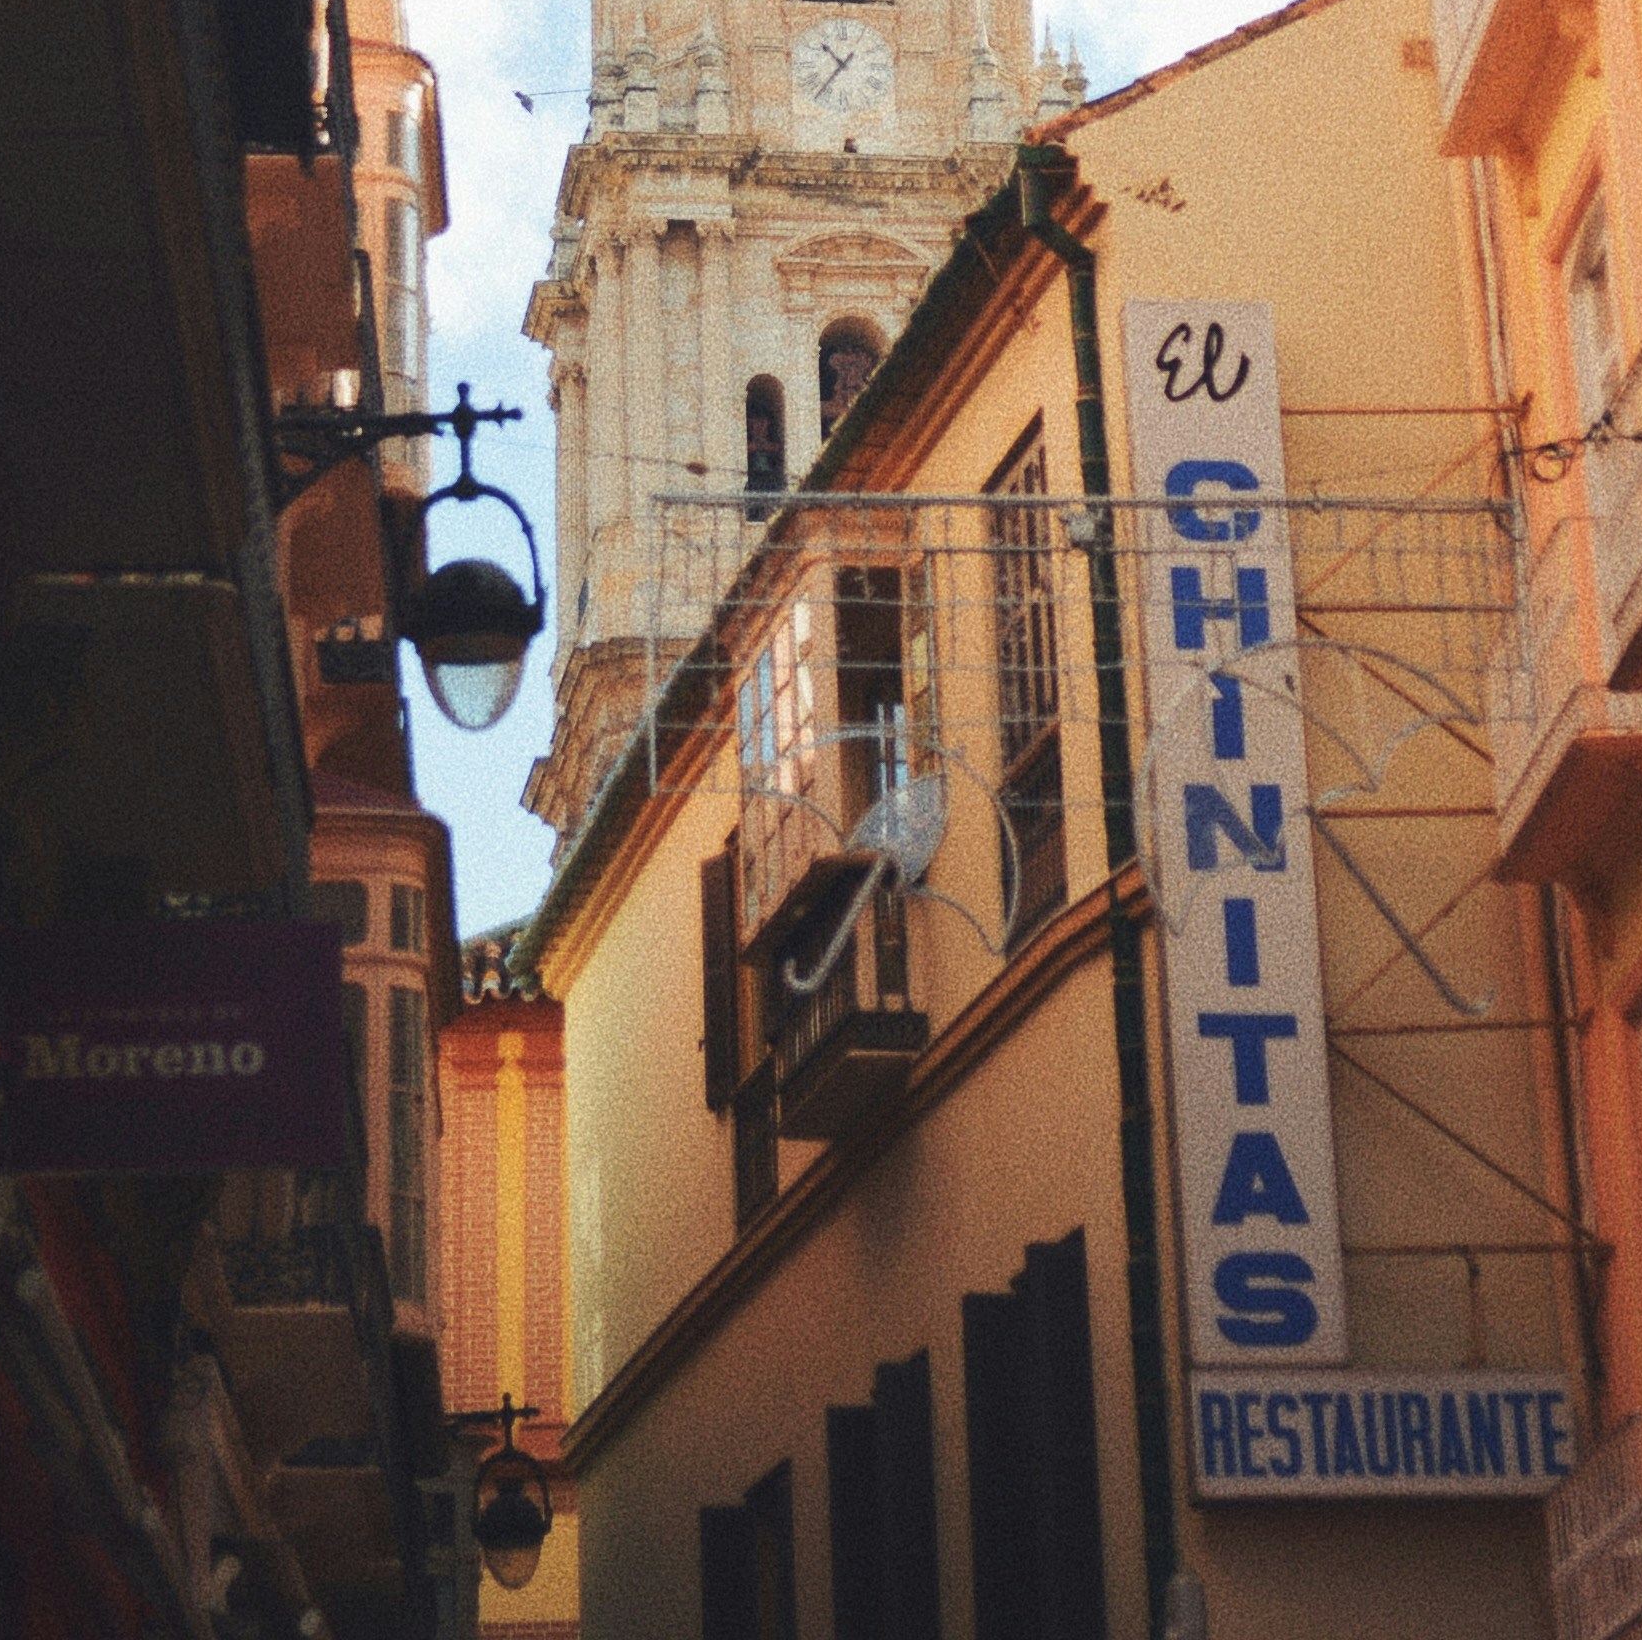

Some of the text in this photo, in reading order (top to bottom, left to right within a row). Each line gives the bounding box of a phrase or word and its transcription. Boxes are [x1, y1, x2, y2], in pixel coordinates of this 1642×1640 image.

[1156, 321, 1250, 402] El
[1165, 460, 1319, 1348] CHINITAS
[21, 1031, 266, 1080] Moreno
[1199, 1390, 1571, 1479] RESTAURANTE
